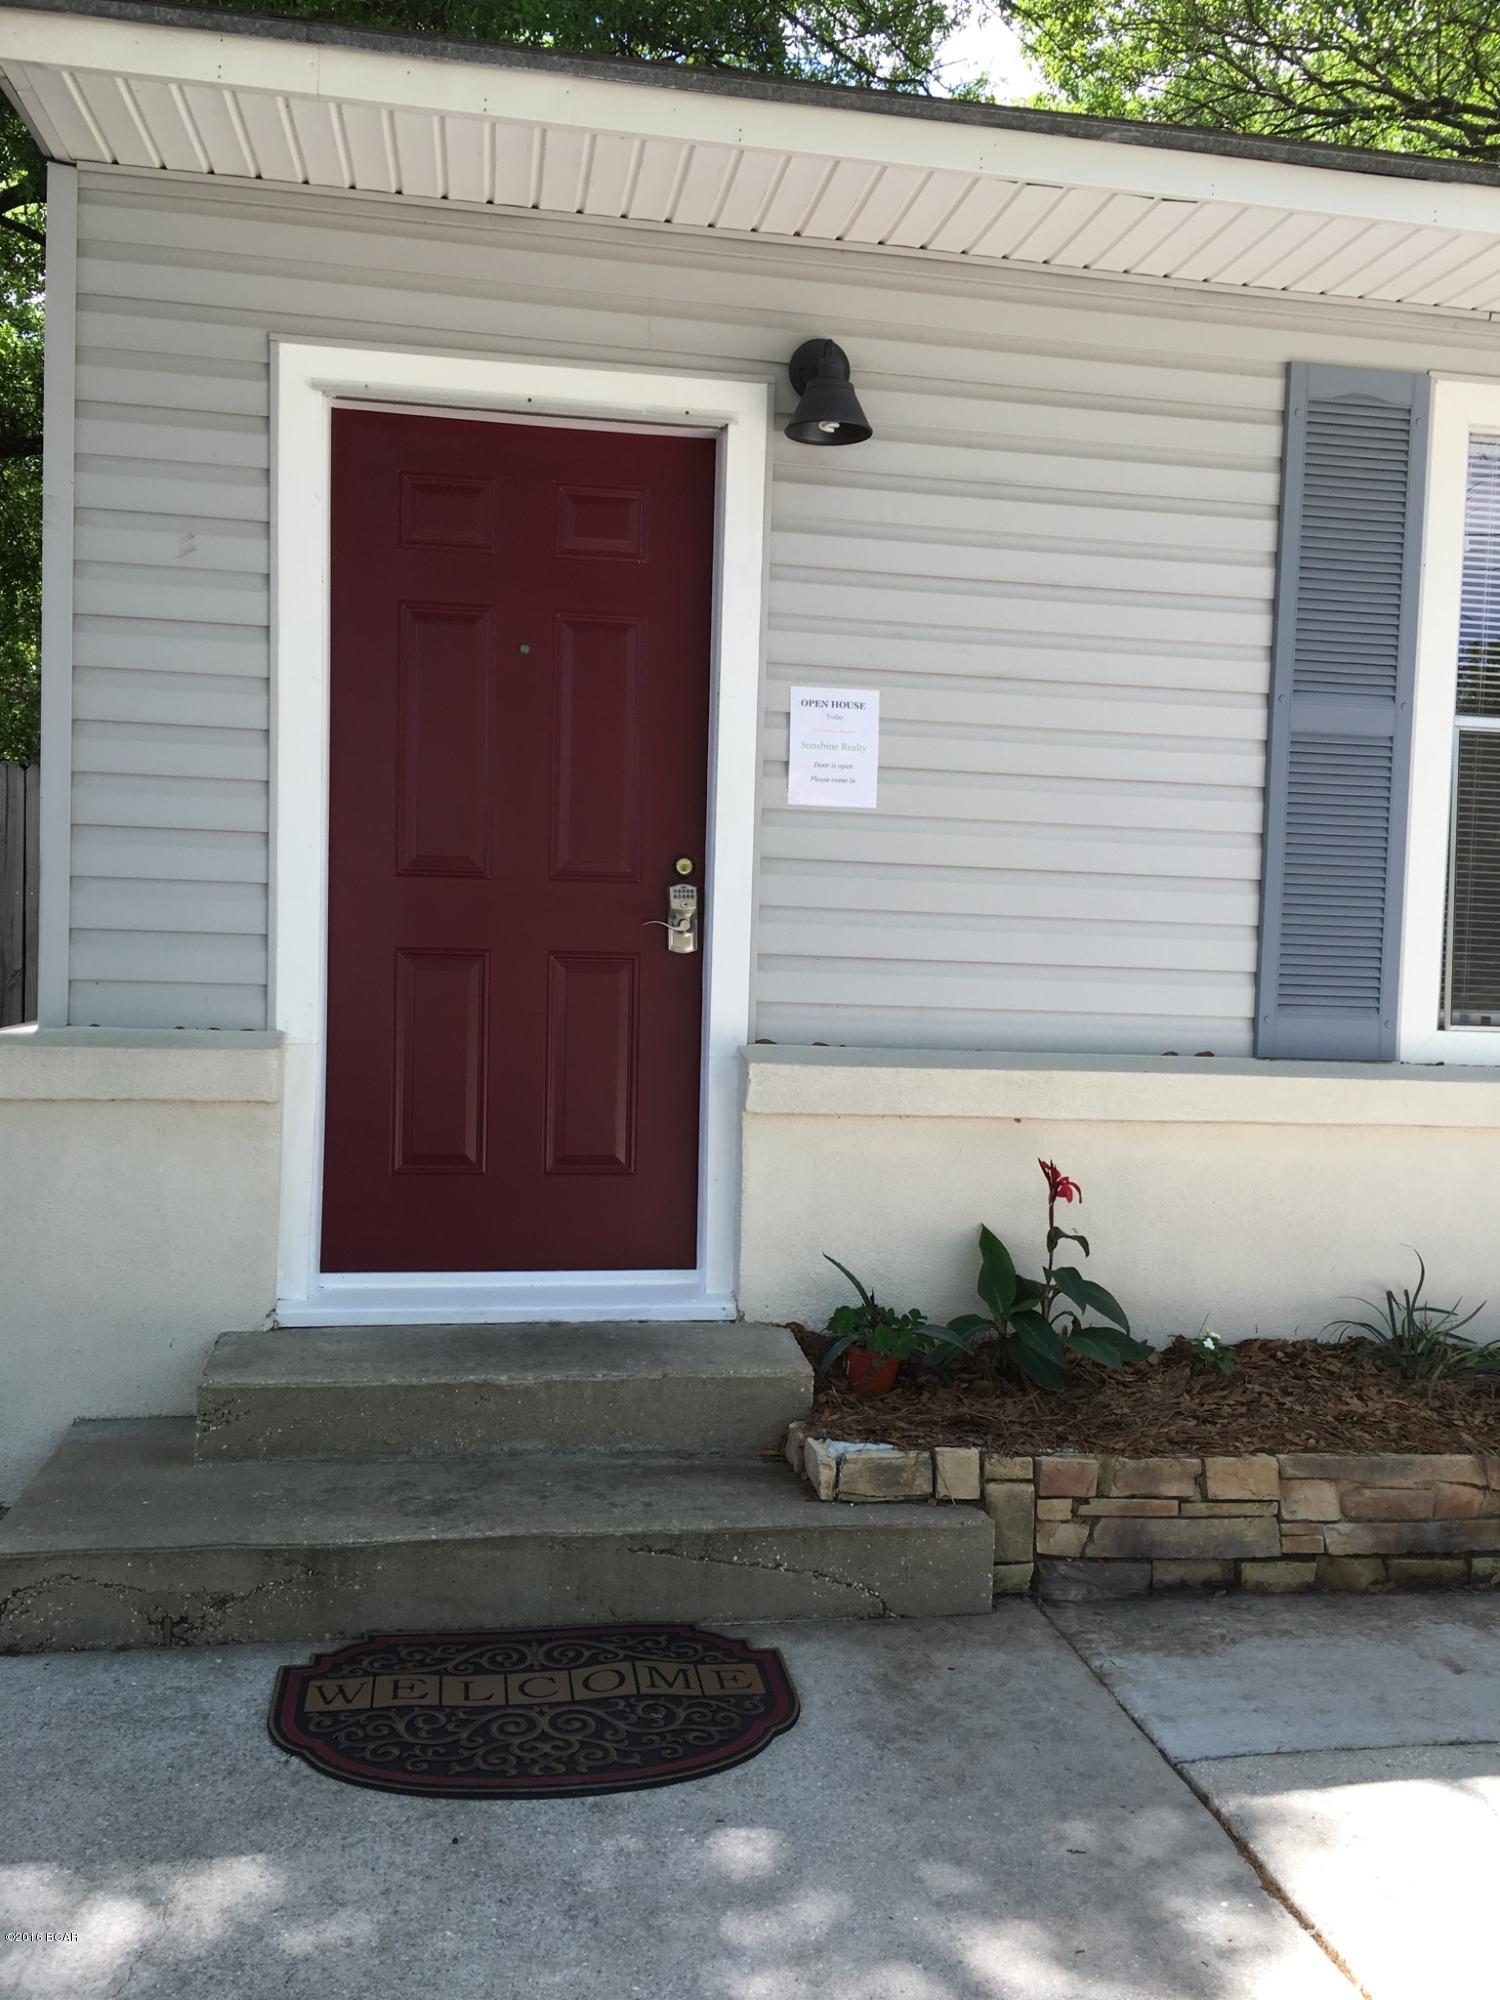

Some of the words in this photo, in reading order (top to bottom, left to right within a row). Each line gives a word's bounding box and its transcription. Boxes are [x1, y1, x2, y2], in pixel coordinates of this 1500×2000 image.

[801, 699, 829, 708] OPEN
[831, 700, 866, 710] HOUSE
[826, 713, 844, 721] Today
[800, 741, 839, 751] Sunshine
[841, 742, 866, 753] Realty
[316, 1664, 753, 1706] WELCOME
